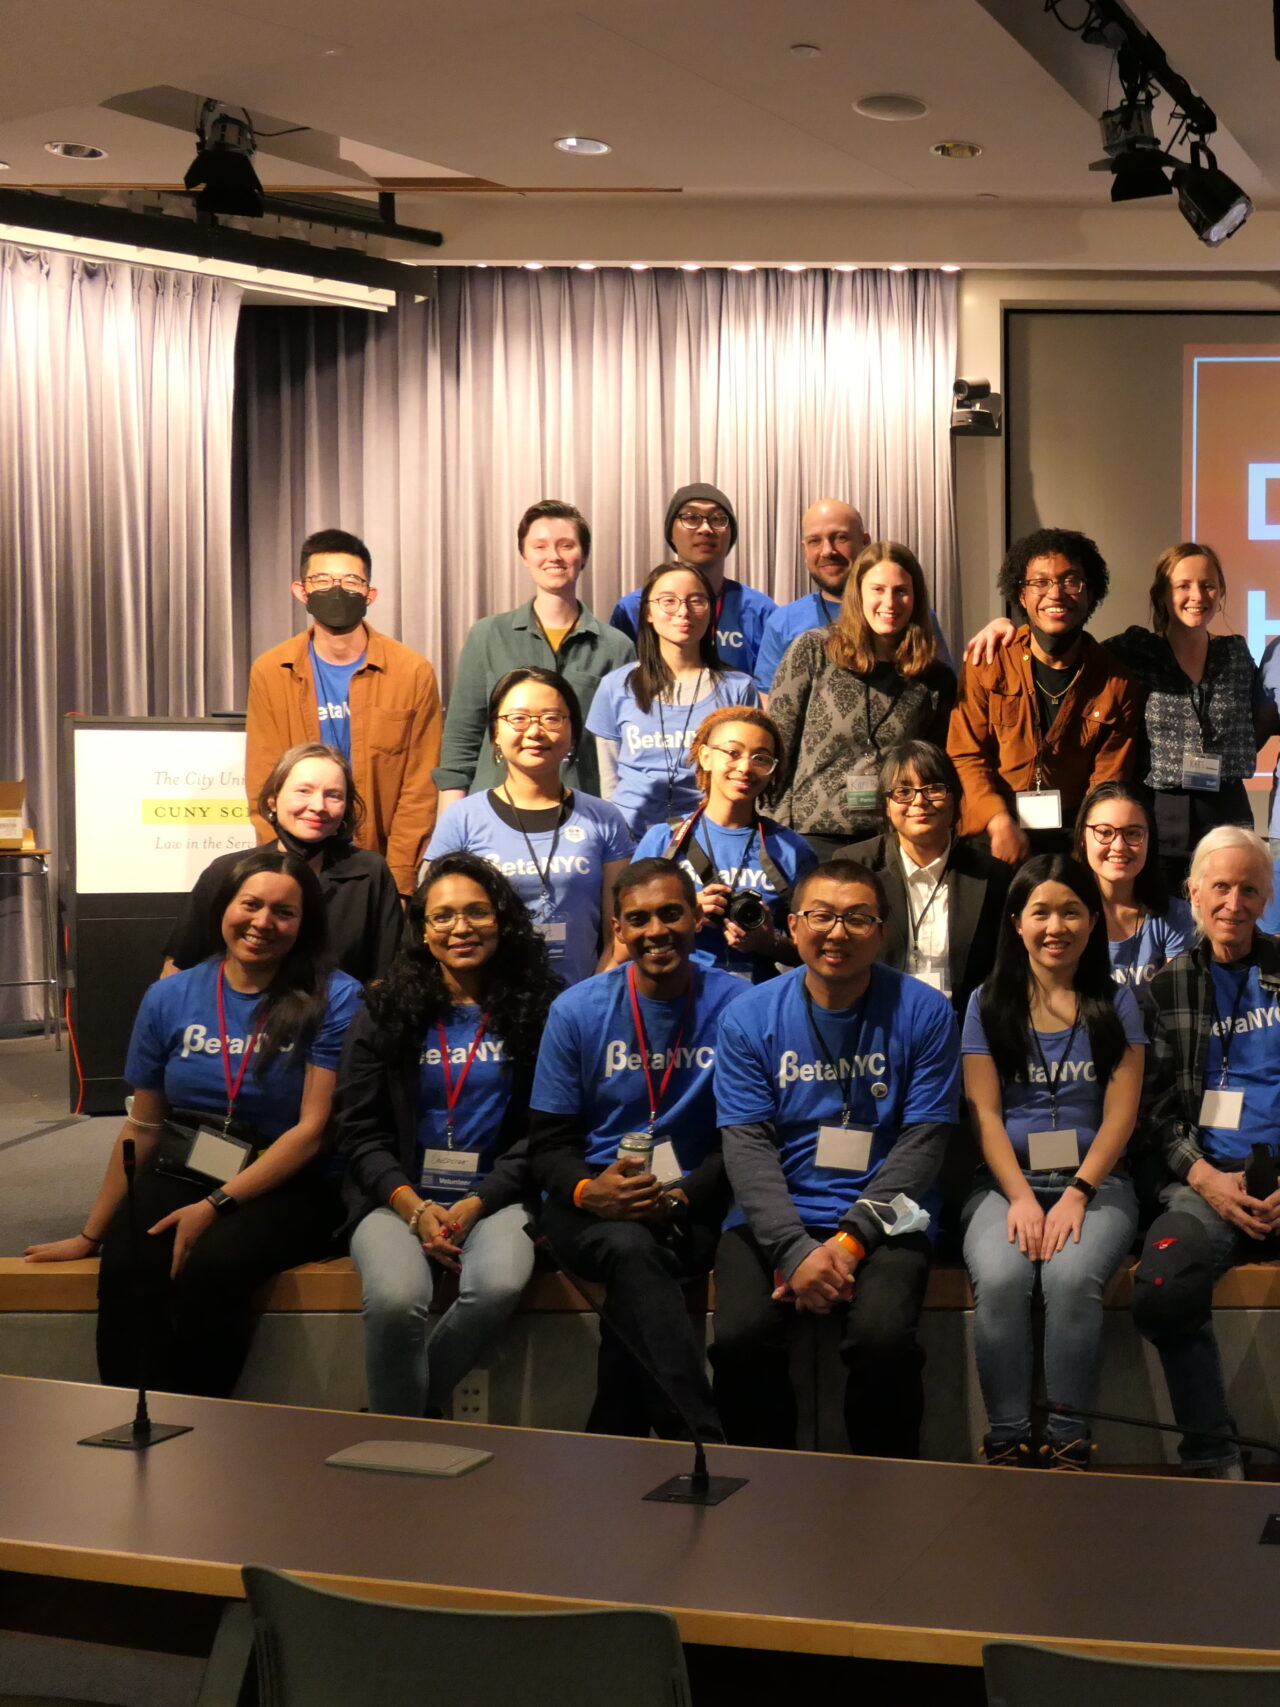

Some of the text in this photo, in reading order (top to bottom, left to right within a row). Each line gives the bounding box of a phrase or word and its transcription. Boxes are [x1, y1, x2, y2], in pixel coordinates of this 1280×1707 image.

[154, 771, 180, 786] The
[185, 771, 214, 791] City
[154, 806, 213, 818] CUNY
[155, 836, 182, 850] Law
[186, 837, 199, 849] in
[202, 836, 222, 849] the
